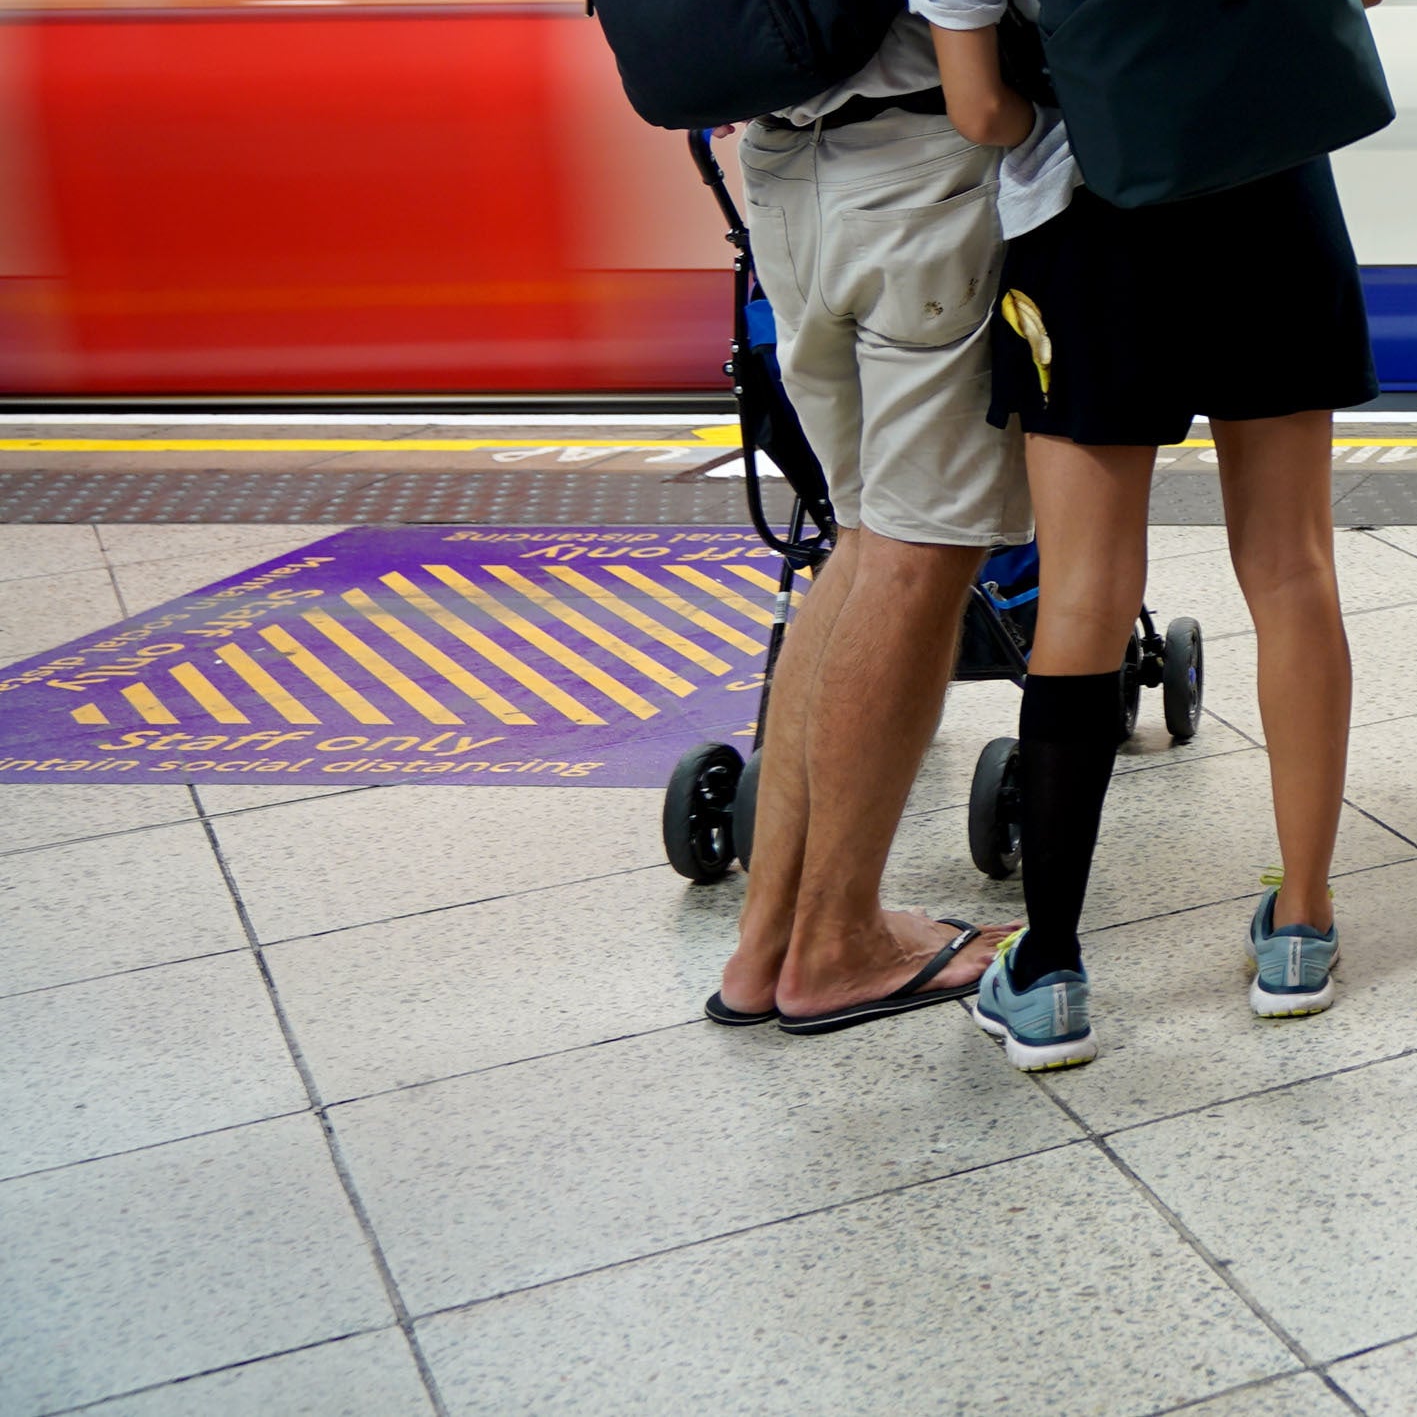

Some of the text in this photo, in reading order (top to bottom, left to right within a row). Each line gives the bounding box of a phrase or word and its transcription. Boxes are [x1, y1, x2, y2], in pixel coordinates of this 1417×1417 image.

[442, 532, 658, 546] distancing
[520, 543, 671, 562] only
[187, 556, 336, 610] Maintain
[46, 588, 325, 692] Staff only
[84, 612, 190, 656] social
[98, 730, 506, 757] Staff only
[148, 757, 315, 772] social
[322, 757, 604, 778] distancing
